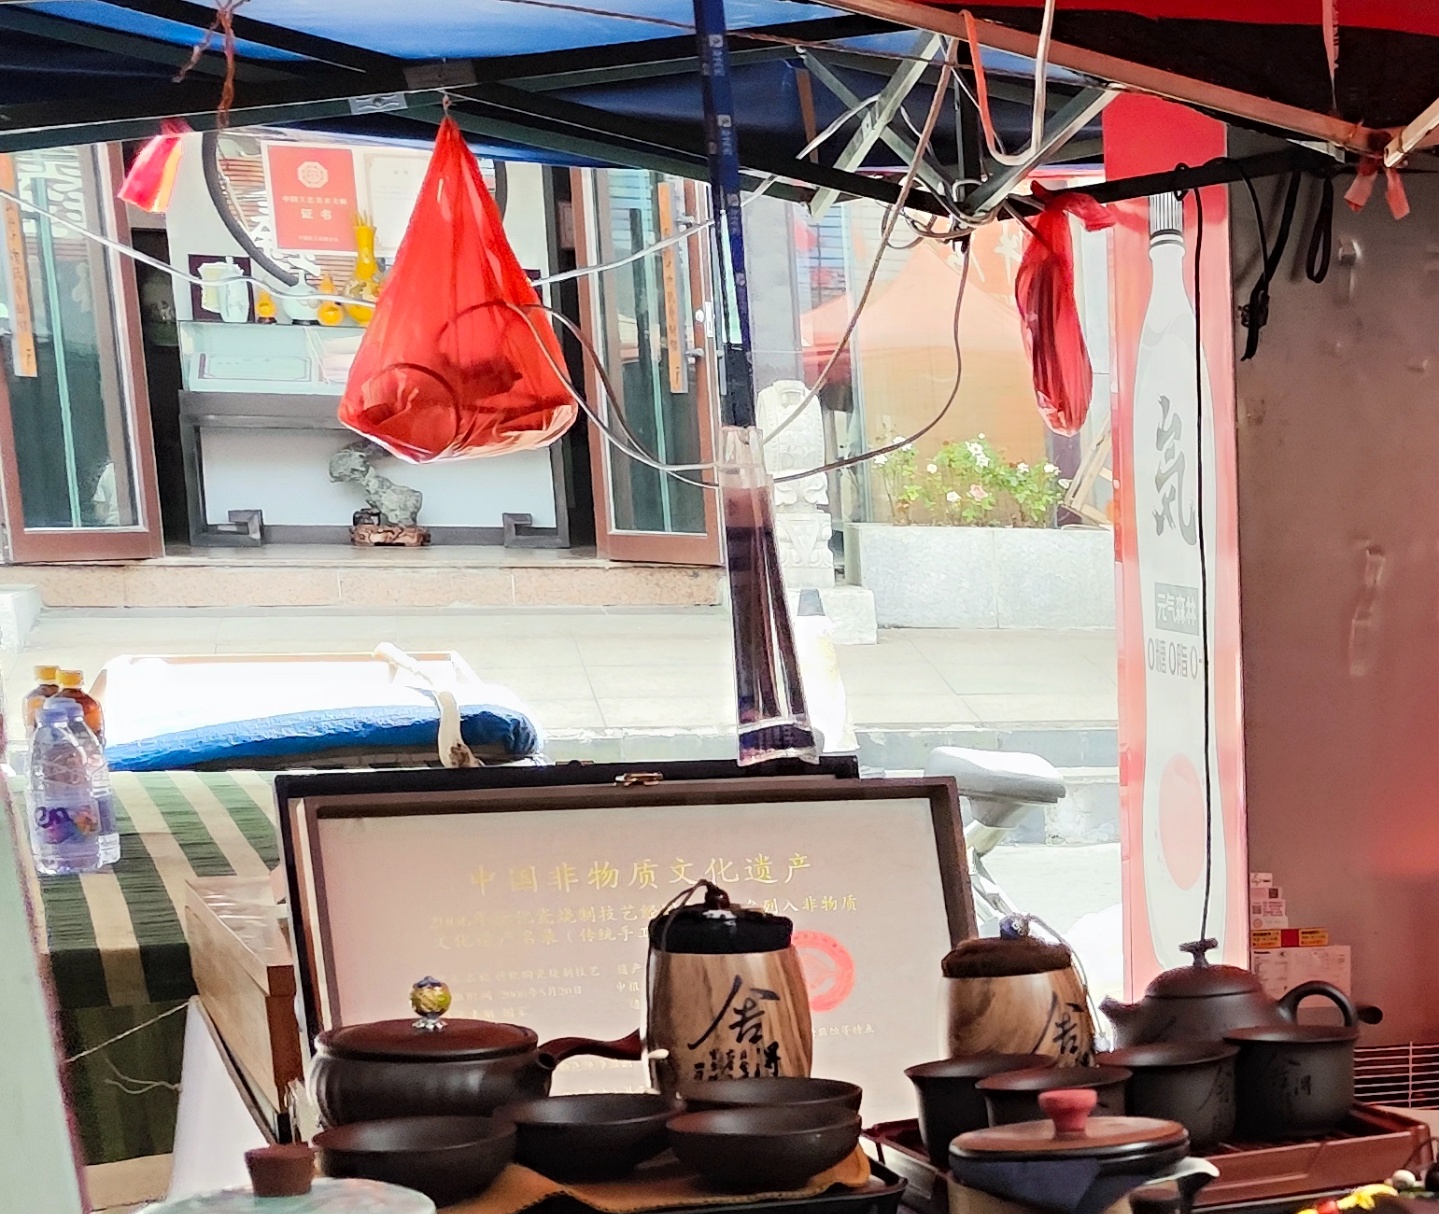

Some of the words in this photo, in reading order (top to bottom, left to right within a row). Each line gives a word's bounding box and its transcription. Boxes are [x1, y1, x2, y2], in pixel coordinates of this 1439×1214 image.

[1156, 592, 1198, 627] 元气森林
[1147, 636, 1203, 681] 0糖0脂0
[470, 852, 812, 896] 中国非物质文化遗产
